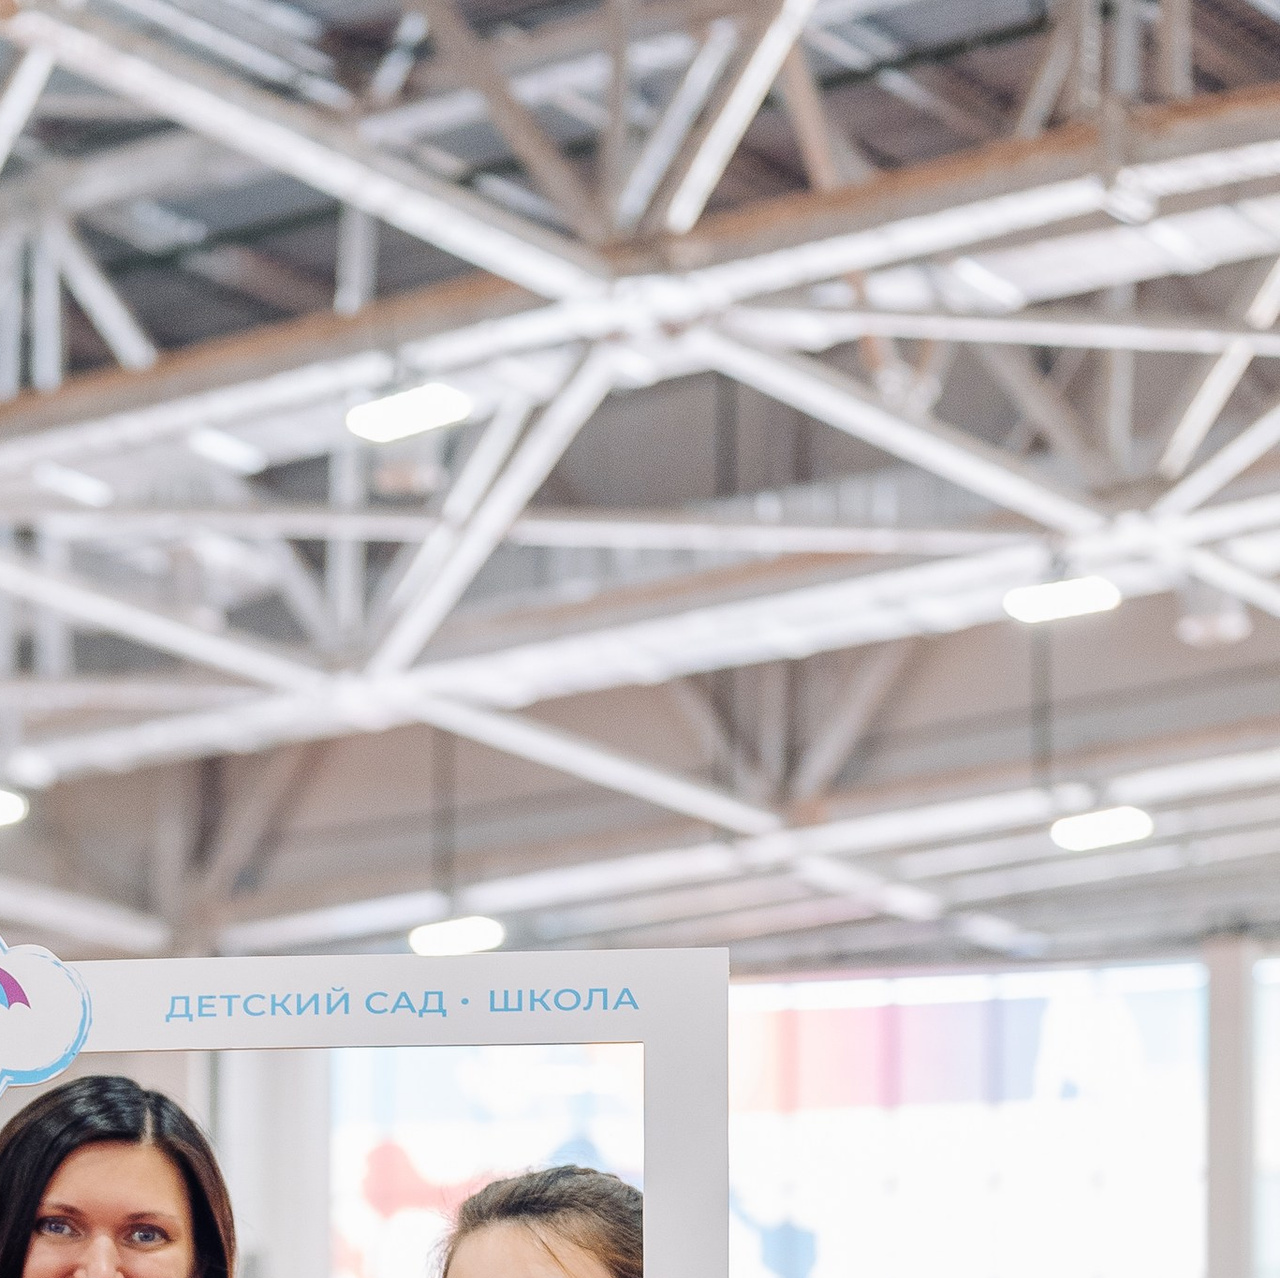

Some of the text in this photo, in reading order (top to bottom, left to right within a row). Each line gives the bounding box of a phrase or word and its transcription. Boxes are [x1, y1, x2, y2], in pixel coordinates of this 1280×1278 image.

[165, 986, 640, 1022] ДЕТСКИЙ САД ШКОЛА
